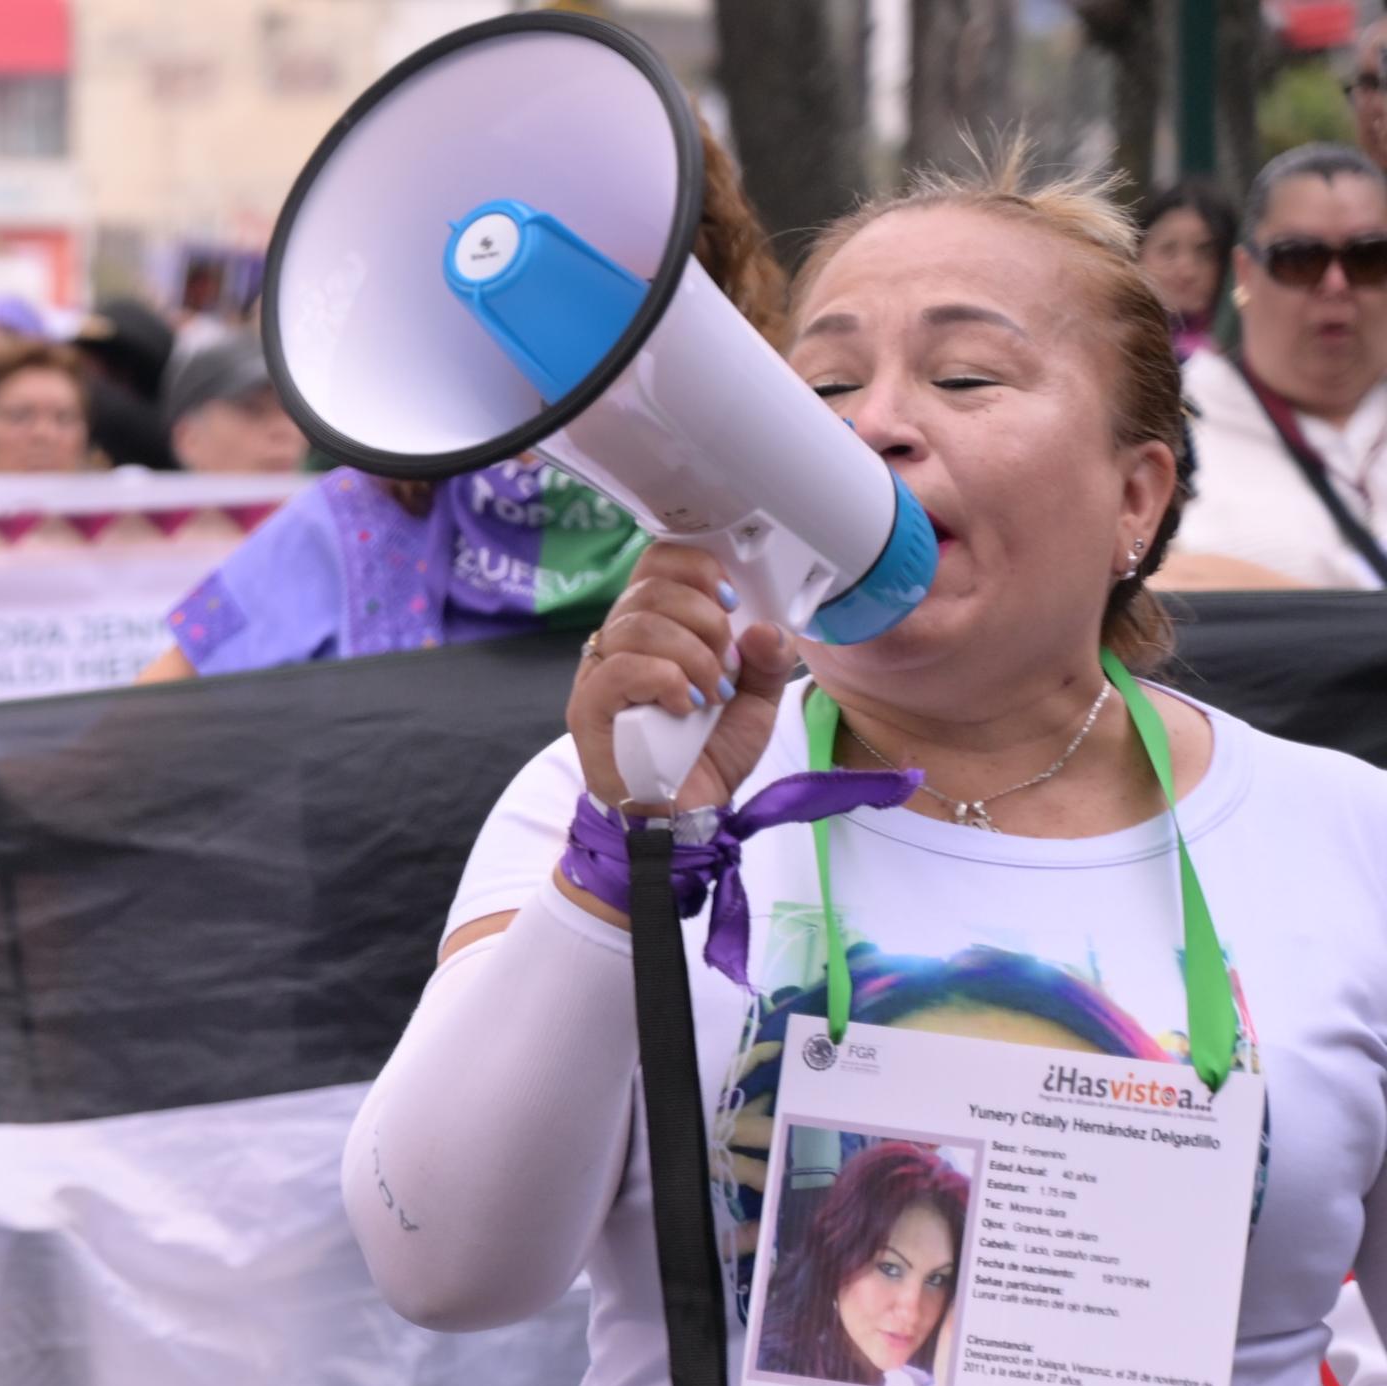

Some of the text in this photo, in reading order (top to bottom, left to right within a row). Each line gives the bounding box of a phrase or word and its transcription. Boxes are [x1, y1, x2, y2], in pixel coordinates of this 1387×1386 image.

[848, 1044, 877, 1061] FGR
[967, 1104, 1017, 1125] Yunery
[1072, 1117, 1147, 1141] Hernández
[1150, 1128, 1220, 1153] Delgadillo
[1022, 1145, 1067, 1160] Femenino
[988, 1160, 1013, 1172] Edad
[1015, 1164, 1048, 1177] Actual:
[986, 1179, 1028, 1193] Estatura:
[1009, 1202, 1043, 1215] Morena
[978, 1237, 1018, 1251] Cabello:
[1076, 1231, 1099, 1242] claro
[976, 1257, 1005, 1270] Fecha
[1008, 1261, 1019, 1271] de
[1021, 1263, 1076, 1279] nacimiento:
[974, 1274, 1003, 1287] Señas
[1008, 1368, 1031, 1380] edad
[1032, 1371, 1044, 1382] de
[1046, 1373, 1057, 1383] 27
[1021, 1357, 1034, 1367] en
[1139, 1372, 1151, 1383] de
